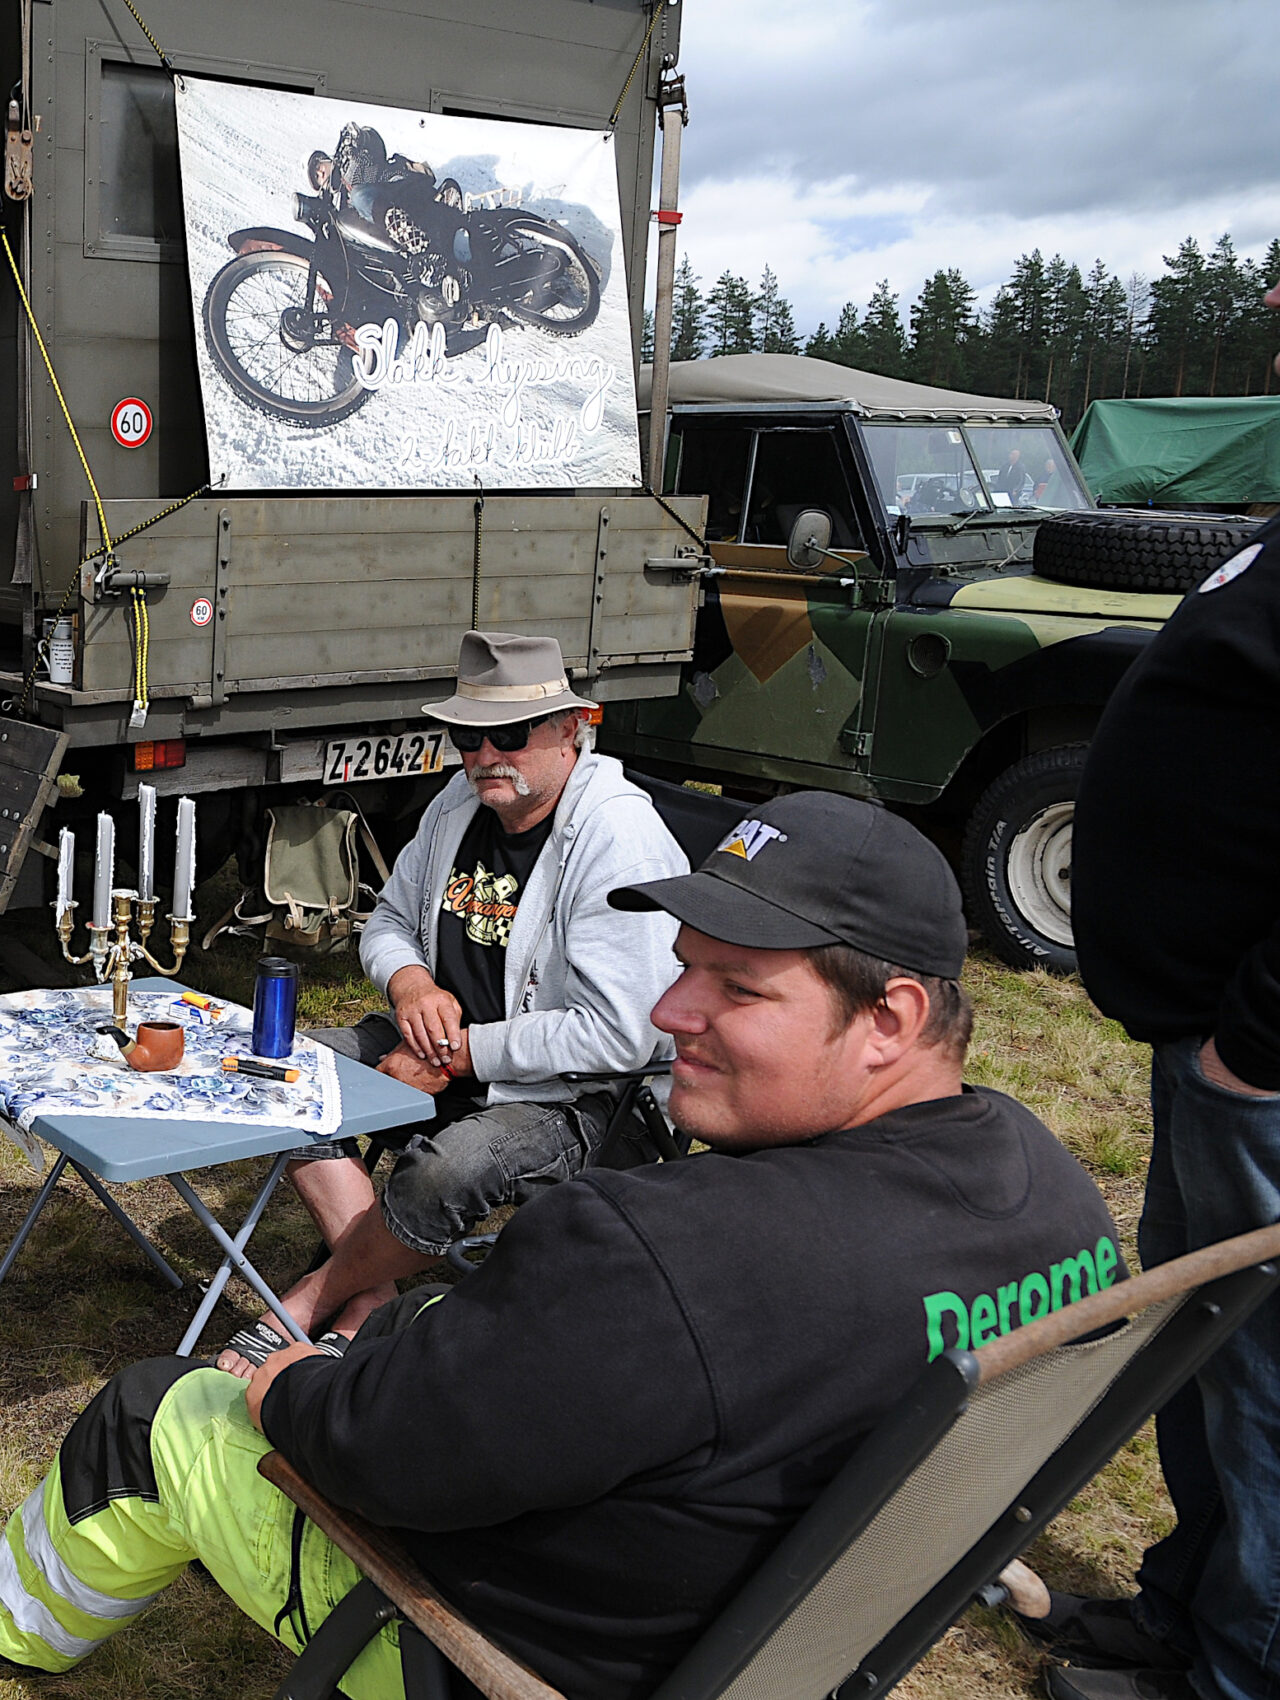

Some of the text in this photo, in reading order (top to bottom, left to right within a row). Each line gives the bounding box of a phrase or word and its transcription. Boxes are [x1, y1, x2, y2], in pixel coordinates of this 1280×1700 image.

[477, 322, 615, 433] hyssing
[120, 411, 143, 434] 60
[400, 417, 583, 468] 2-takt klubb
[195, 605, 207, 616] 60
[922, 1236, 1118, 1365] Derome
